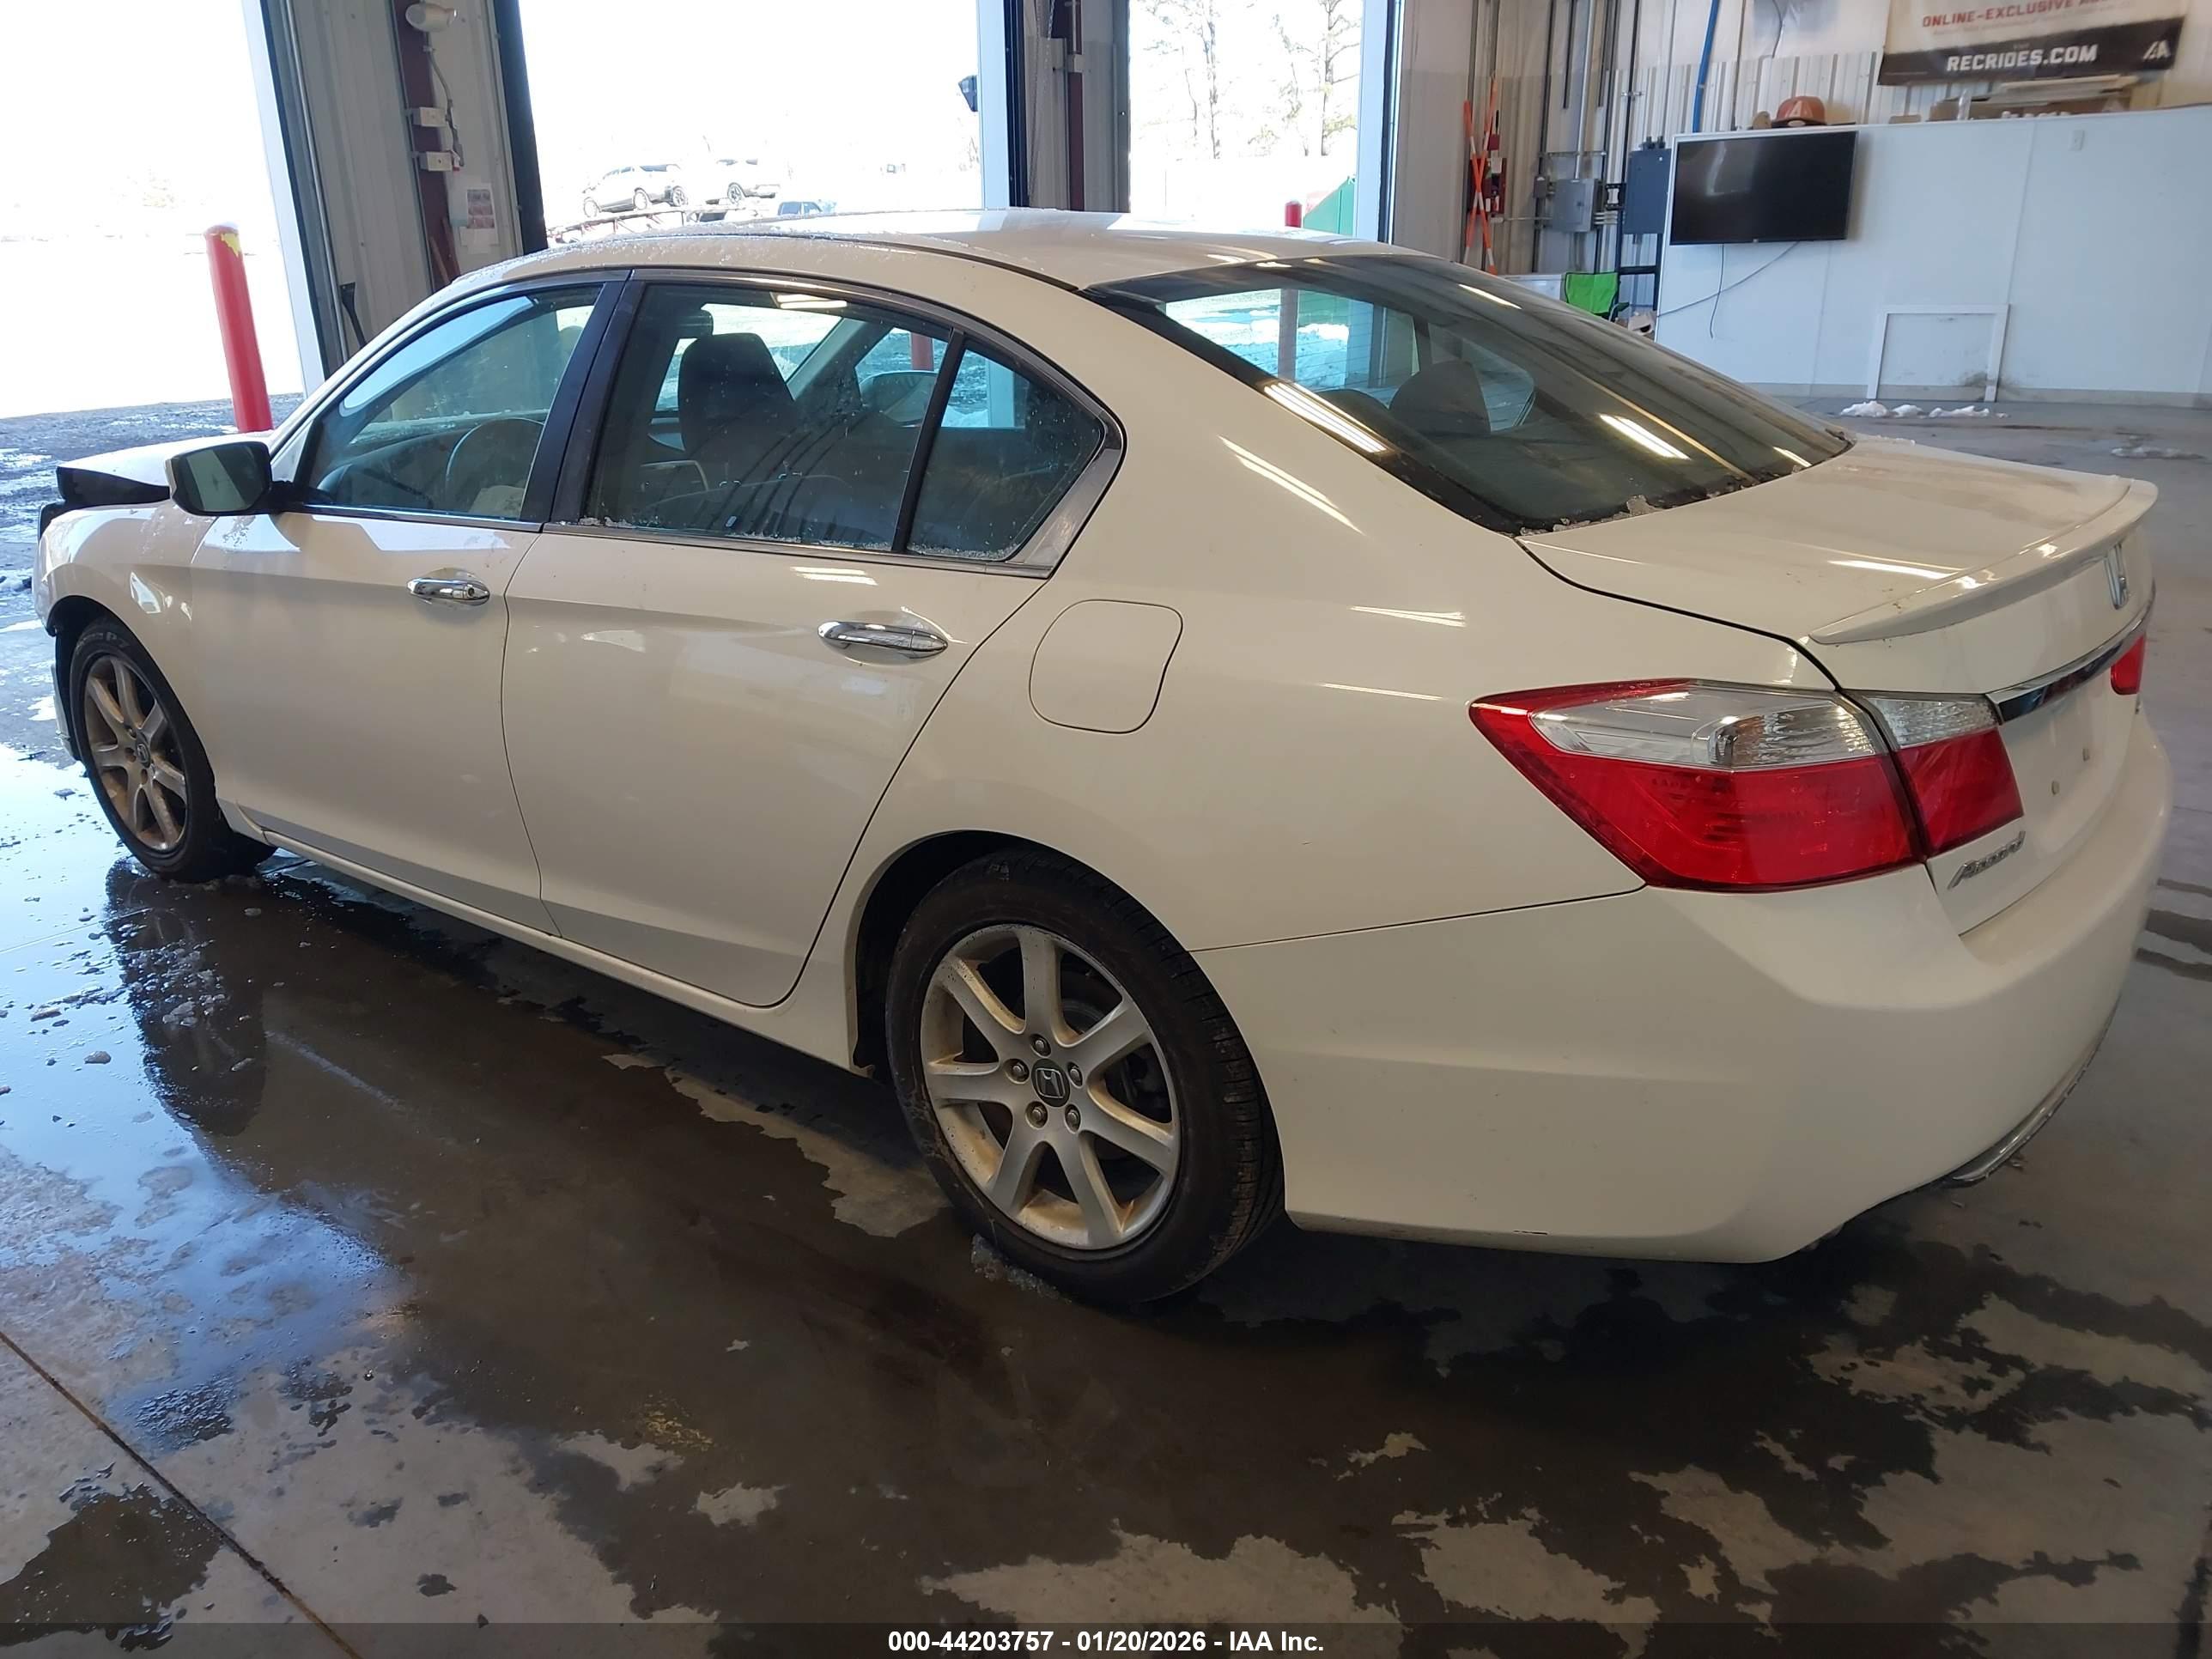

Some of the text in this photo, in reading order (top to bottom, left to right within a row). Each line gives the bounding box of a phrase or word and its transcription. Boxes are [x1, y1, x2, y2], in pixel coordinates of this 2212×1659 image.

[1922, 0, 2078, 28] ONLINE-EXCLUSIVE
[1946, 44, 2099, 71] RECRIDES.COM
[1947, 830, 2027, 890] Accord
